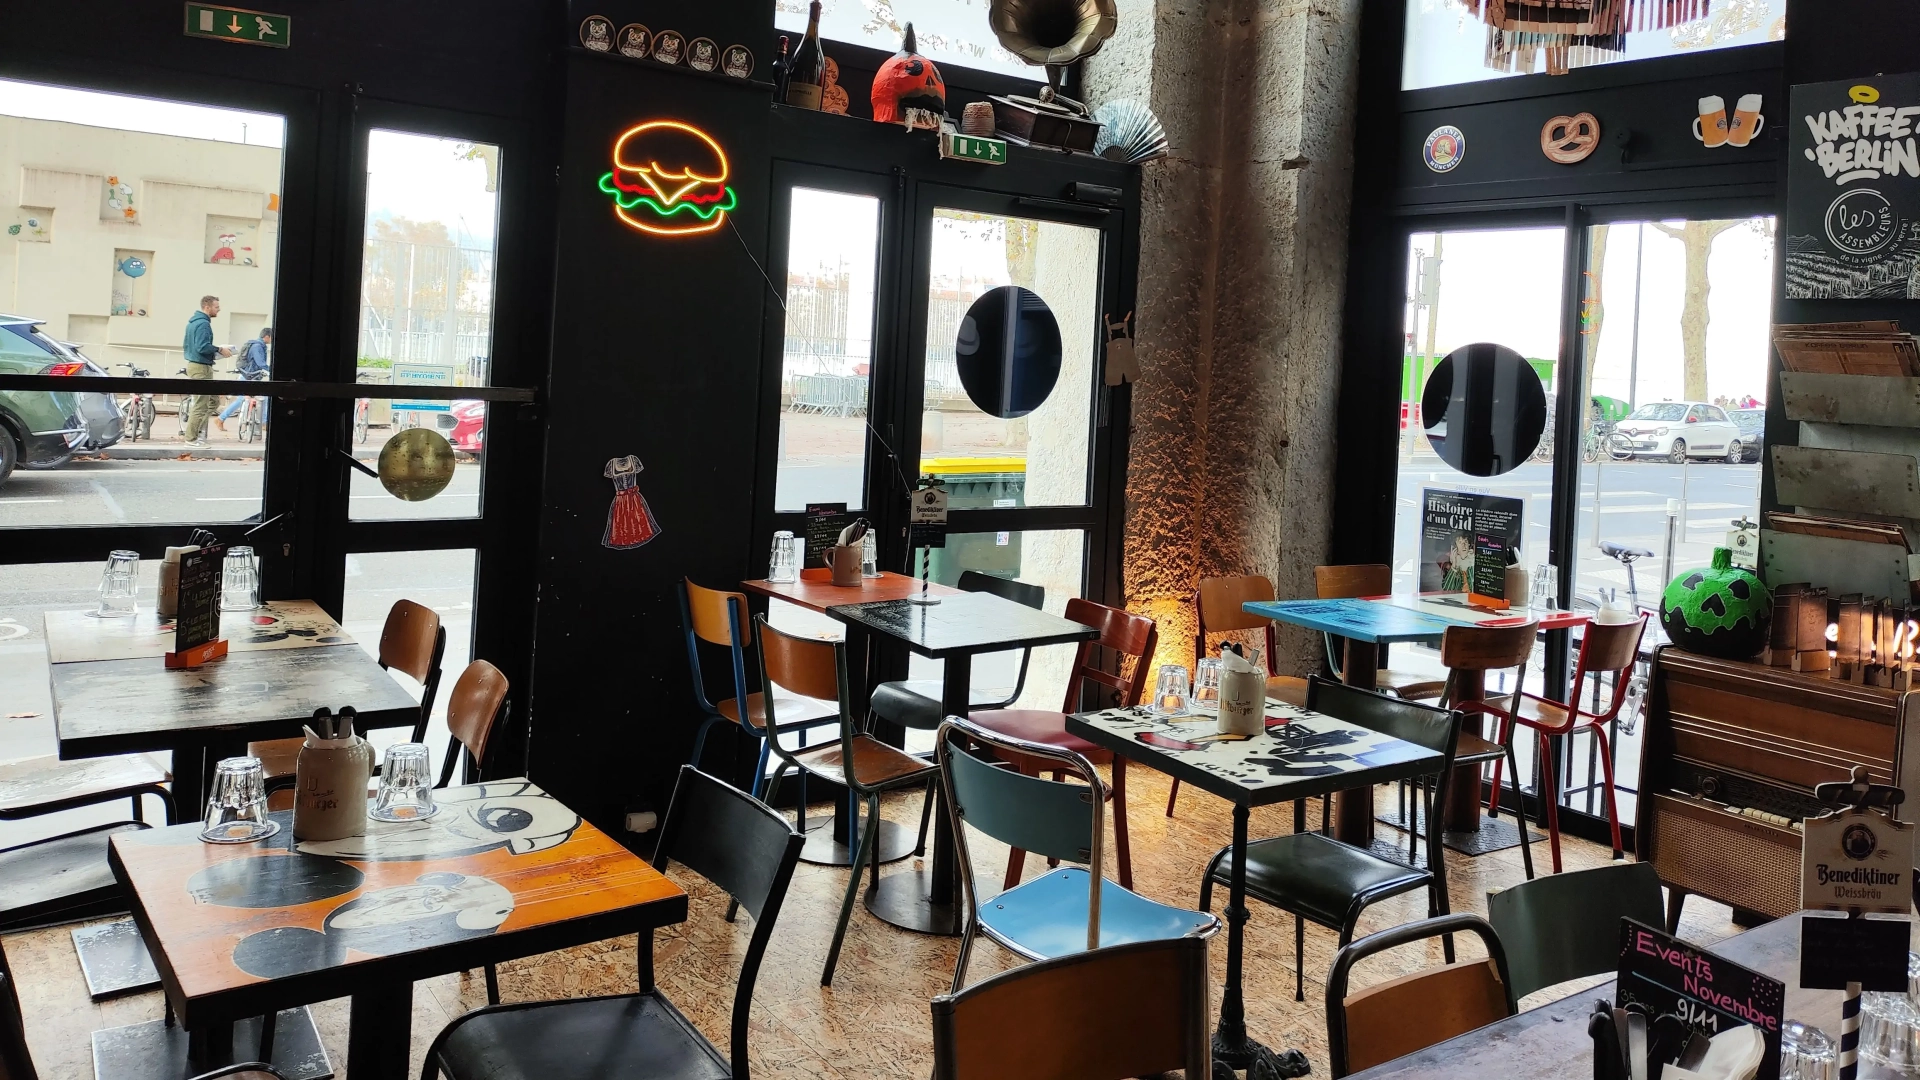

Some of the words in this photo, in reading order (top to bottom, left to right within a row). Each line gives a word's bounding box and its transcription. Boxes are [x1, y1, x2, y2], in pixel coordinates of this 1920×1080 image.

[1426, 129, 1462, 147] PAULANER
[1839, 206, 1891, 248] ASSEMBLEURS
[1889, 242, 1899, 252] au
[1428, 499, 1473, 516] Histoire
[1426, 513, 1447, 525] d'un
[1449, 515, 1472, 531] Cid
[1816, 864, 1901, 885] Benediktiner
[1834, 886, 1881, 899] Weissbräu
[1636, 930, 1713, 982] Events
[1683, 974, 1777, 1031] Novembre
[1676, 998, 1718, 1032] 9/11
